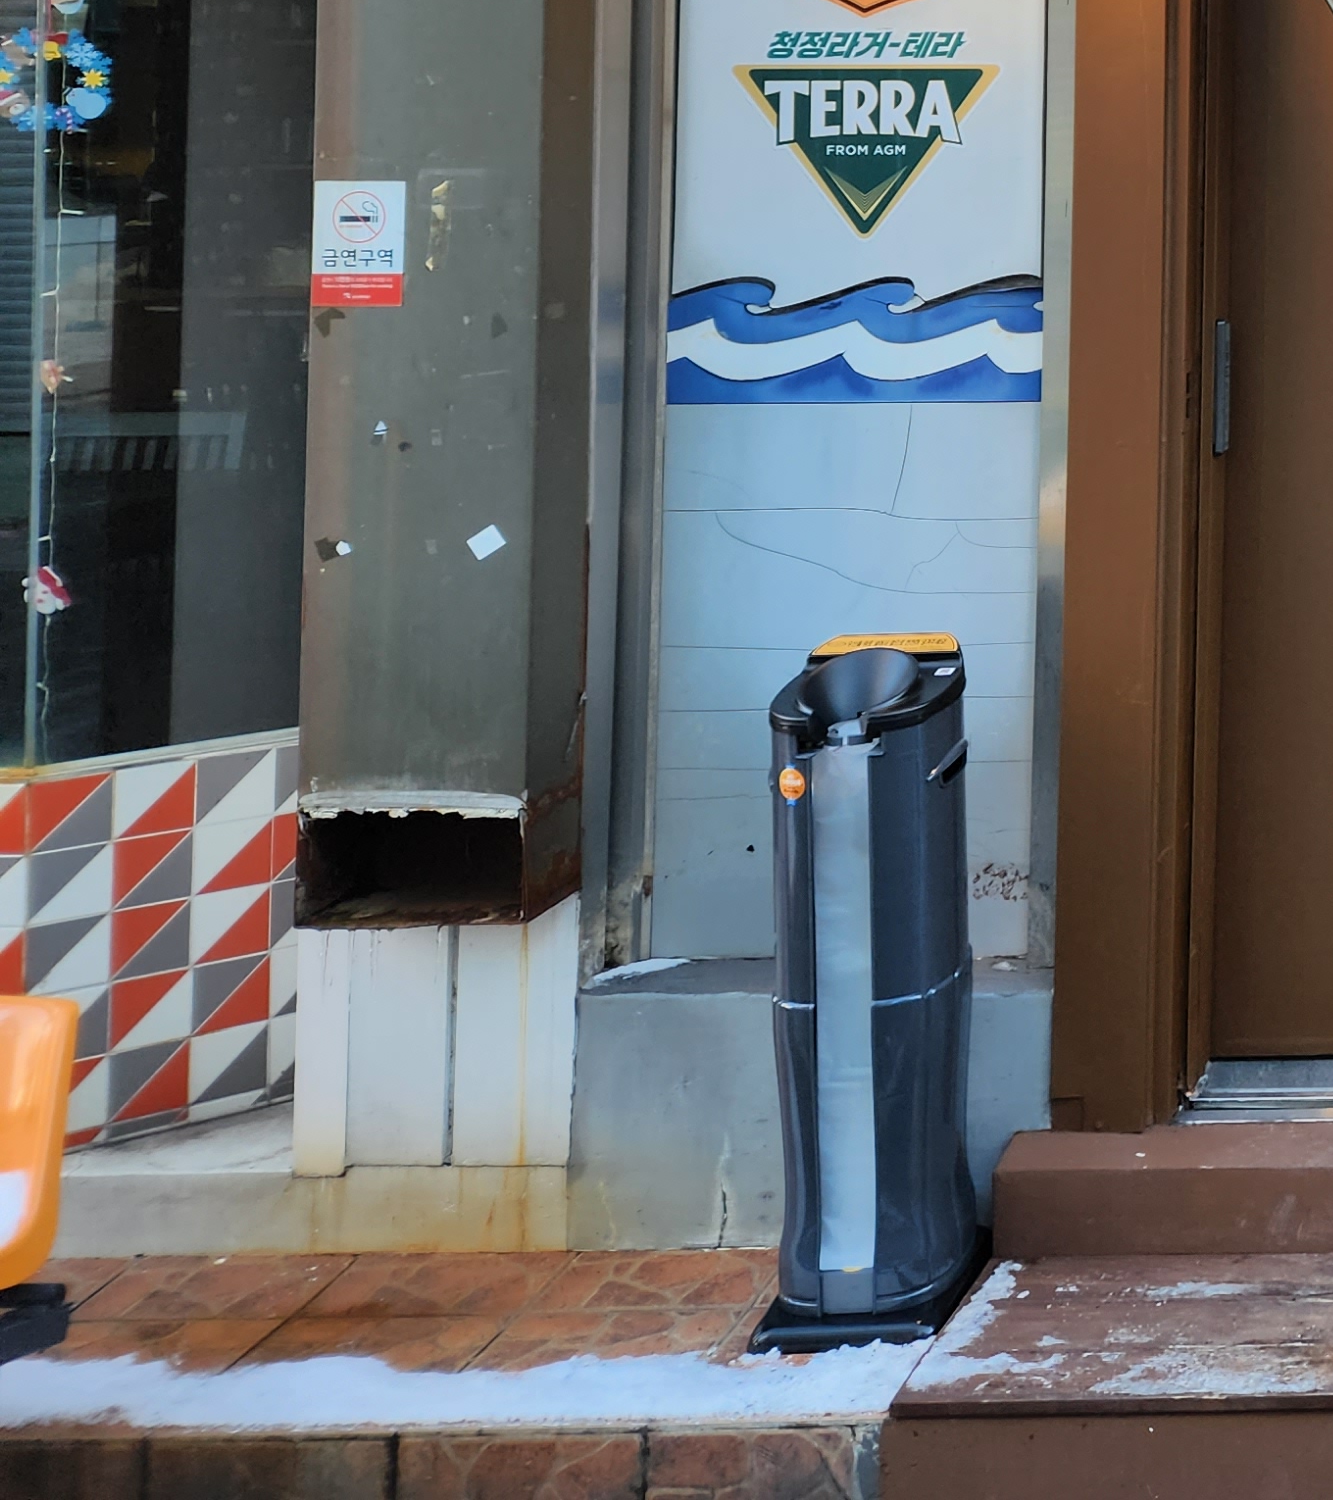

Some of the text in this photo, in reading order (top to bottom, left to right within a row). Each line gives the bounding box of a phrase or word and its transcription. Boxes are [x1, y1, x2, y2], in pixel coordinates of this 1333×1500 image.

[767, 30, 966, 60] 청정라거-테라
[763, 79, 963, 146] TERRA
[826, 144, 906, 156] FROM AGM
[321, 249, 394, 268] 금연구역
